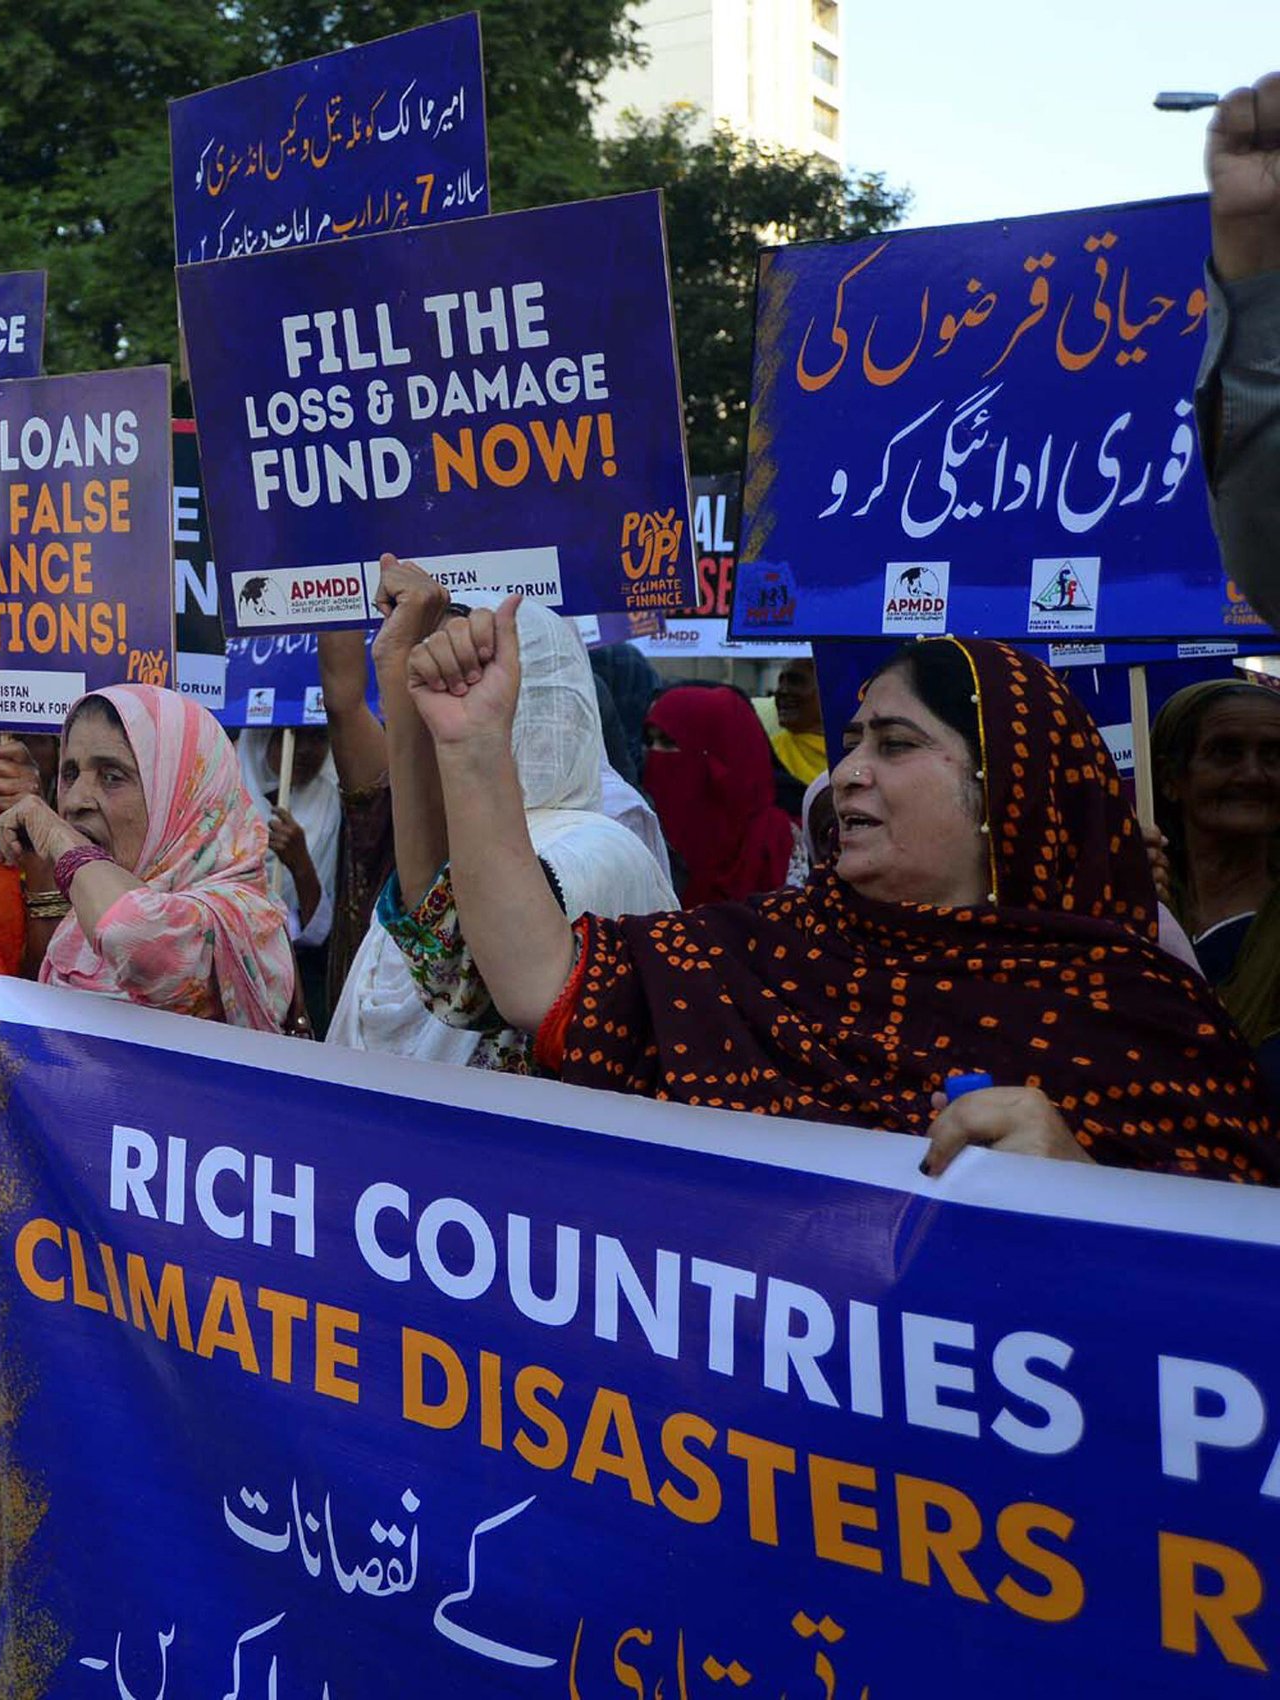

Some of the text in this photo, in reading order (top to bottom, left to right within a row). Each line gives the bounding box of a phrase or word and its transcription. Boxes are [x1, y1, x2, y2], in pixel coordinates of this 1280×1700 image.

[281, 280, 551, 379] FILL THE
[245, 353, 609, 439] LOSS & DAMAGE
[0, 409, 140, 472] LOANS
[251, 413, 617, 511] FUND NOW!
[900, 382, 1053, 539] ادائیگی
[1056, 398, 1195, 534] فوری
[10, 478, 131, 535] FALSE
[621, 507, 675, 548] PAY
[621, 520, 683, 580] UP!
[291, 577, 360, 600] APMDD
[506, 581, 558, 597] FORUM
[626, 592, 683, 608] FINANCE
[632, 579, 682, 596] CLIMATE
[886, 598, 945, 612] APMDD
[126, 649, 164, 681] PAY
[20, 701, 46, 713] FOLK
[110, 1124, 315, 1257] RICH
[355, 1182, 1084, 1454] COUNTRIES
[15, 1217, 360, 1404] CLIMATE
[403, 1326, 1084, 1622] DISASTERS
[224, 1477, 420, 1598] نقصانات
[433, 1495, 558, 1669] کے
